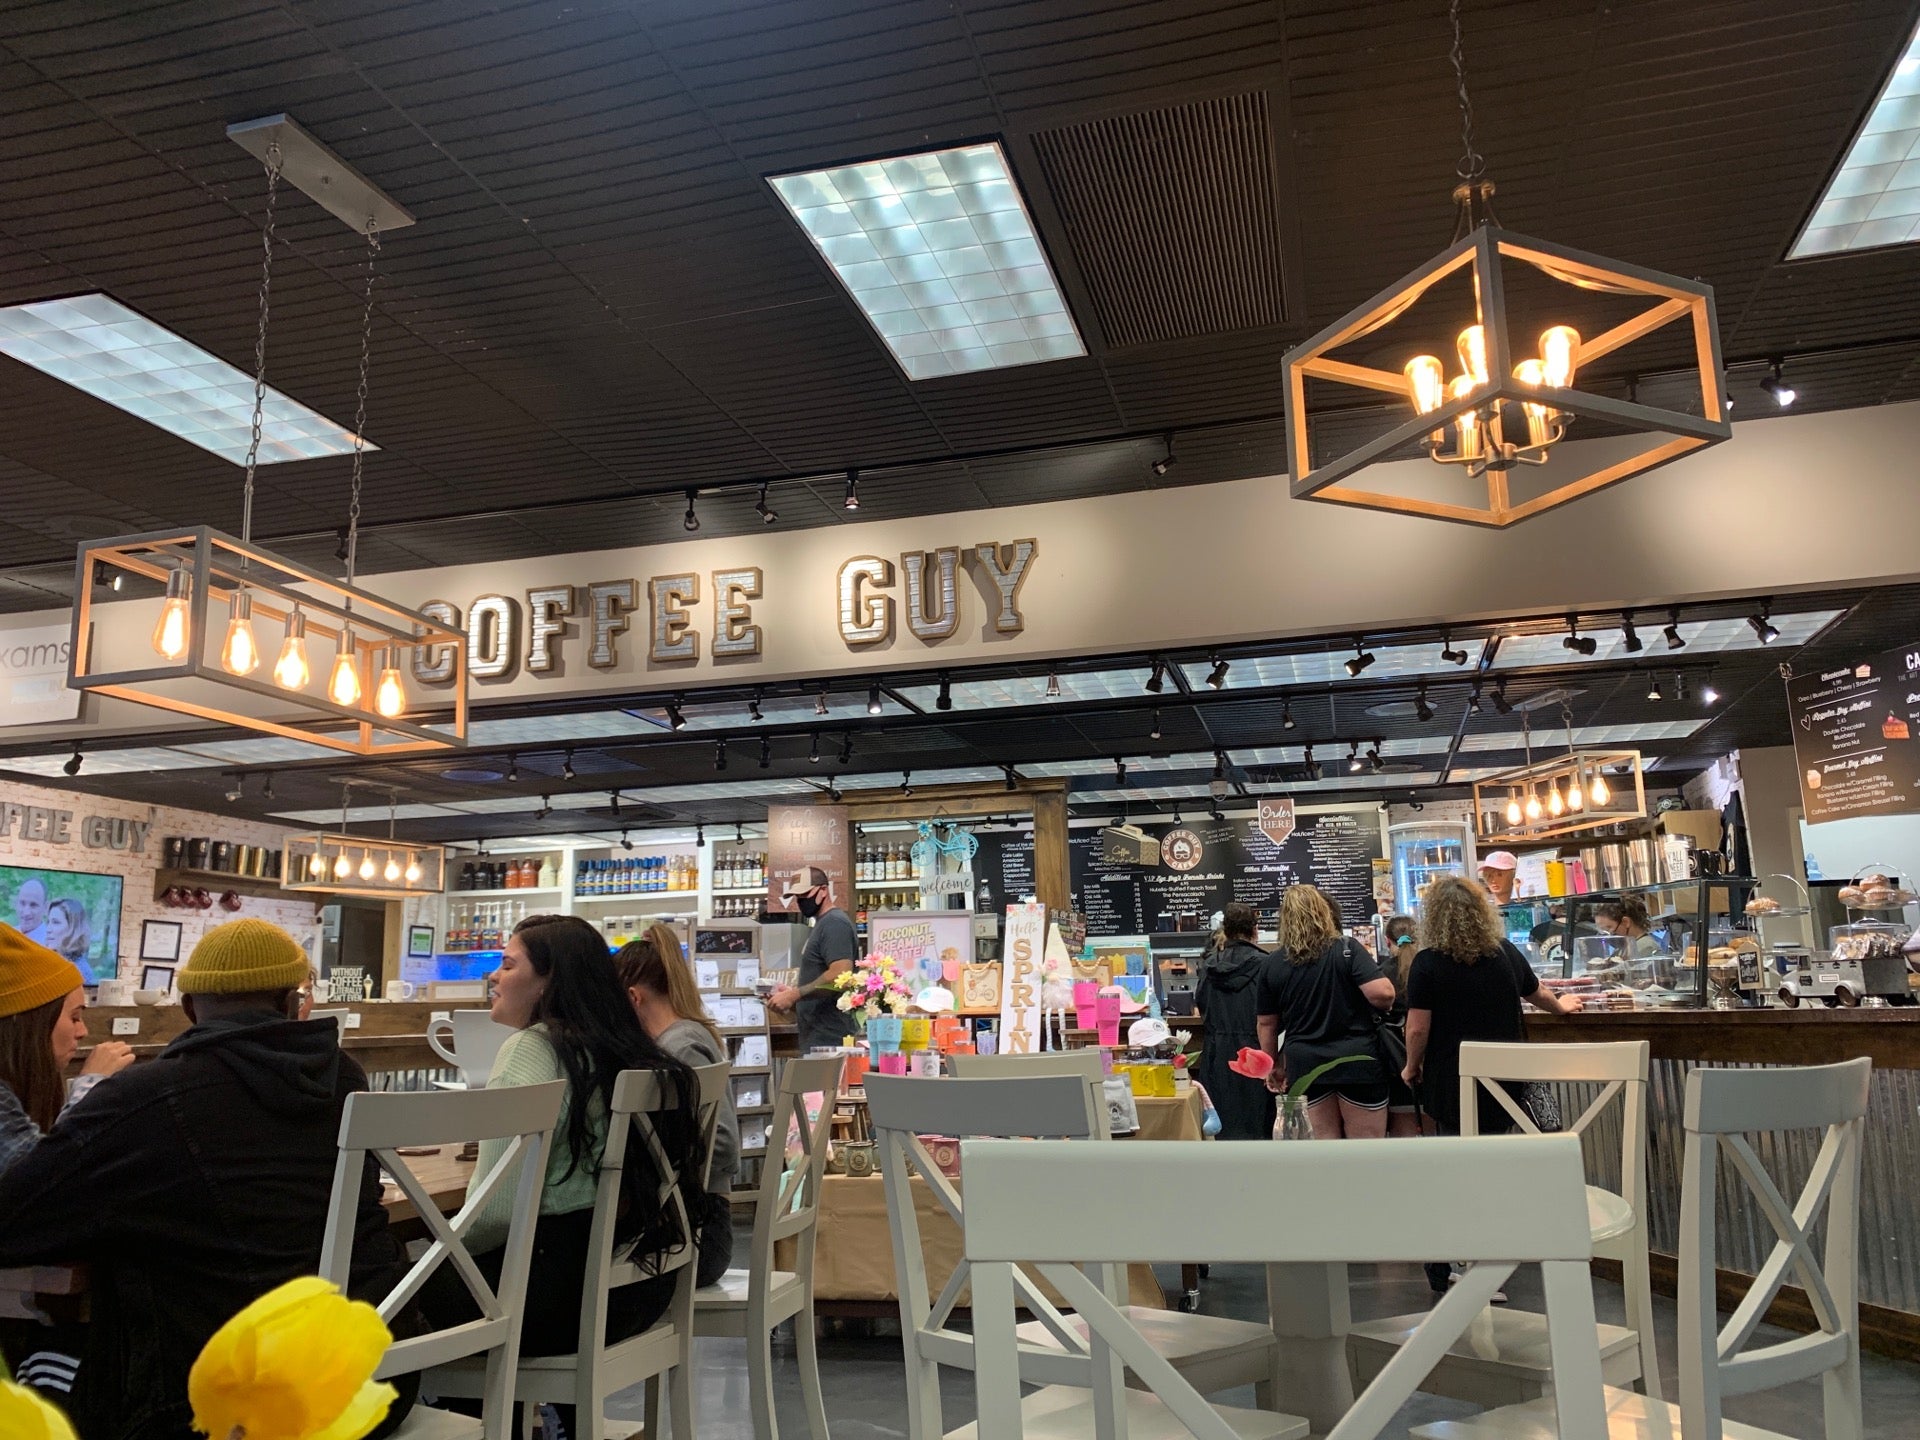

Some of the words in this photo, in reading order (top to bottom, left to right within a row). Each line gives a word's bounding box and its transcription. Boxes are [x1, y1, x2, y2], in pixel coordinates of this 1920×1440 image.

[412, 570, 763, 683] COFFEE
[836, 539, 1039, 646] GUY
[1855, 676, 1881, 688] Strawberry
[1840, 721, 1866, 733] Chocolate
[1832, 741, 1851, 751] Banana
[1851, 738, 1861, 747] Nut
[1820, 780, 1846, 792] Chocolate
[1873, 774, 1888, 783] Filling
[1863, 783, 1879, 792] Cream
[1879, 780, 1894, 789] Filling
[1871, 789, 1886, 798] Filling
[1811, 807, 1828, 816] Coffee
[1828, 804, 1841, 813] Cake
[1891, 793, 1906, 804] Filling
[1261, 805, 1293, 819] Order
[1263, 818, 1293, 830] HERE
[81, 815, 152, 853] GUY
[1162, 830, 1188, 851] COFFEE
[1188, 833, 1202, 849] GUY
[1669, 861, 1684, 872] NEED
[920, 877, 973, 896] welcome
[879, 922, 931, 942] COCONUT
[1010, 921, 1038, 936] Hello
[874, 937, 914, 954] CREAM
[914, 933, 936, 947] PIE
[330, 967, 364, 977] WITHOUT
[330, 976, 363, 987] COFFEE
[334, 986, 363, 995] LITERALLY
[346, 994, 363, 1002] EVEN
